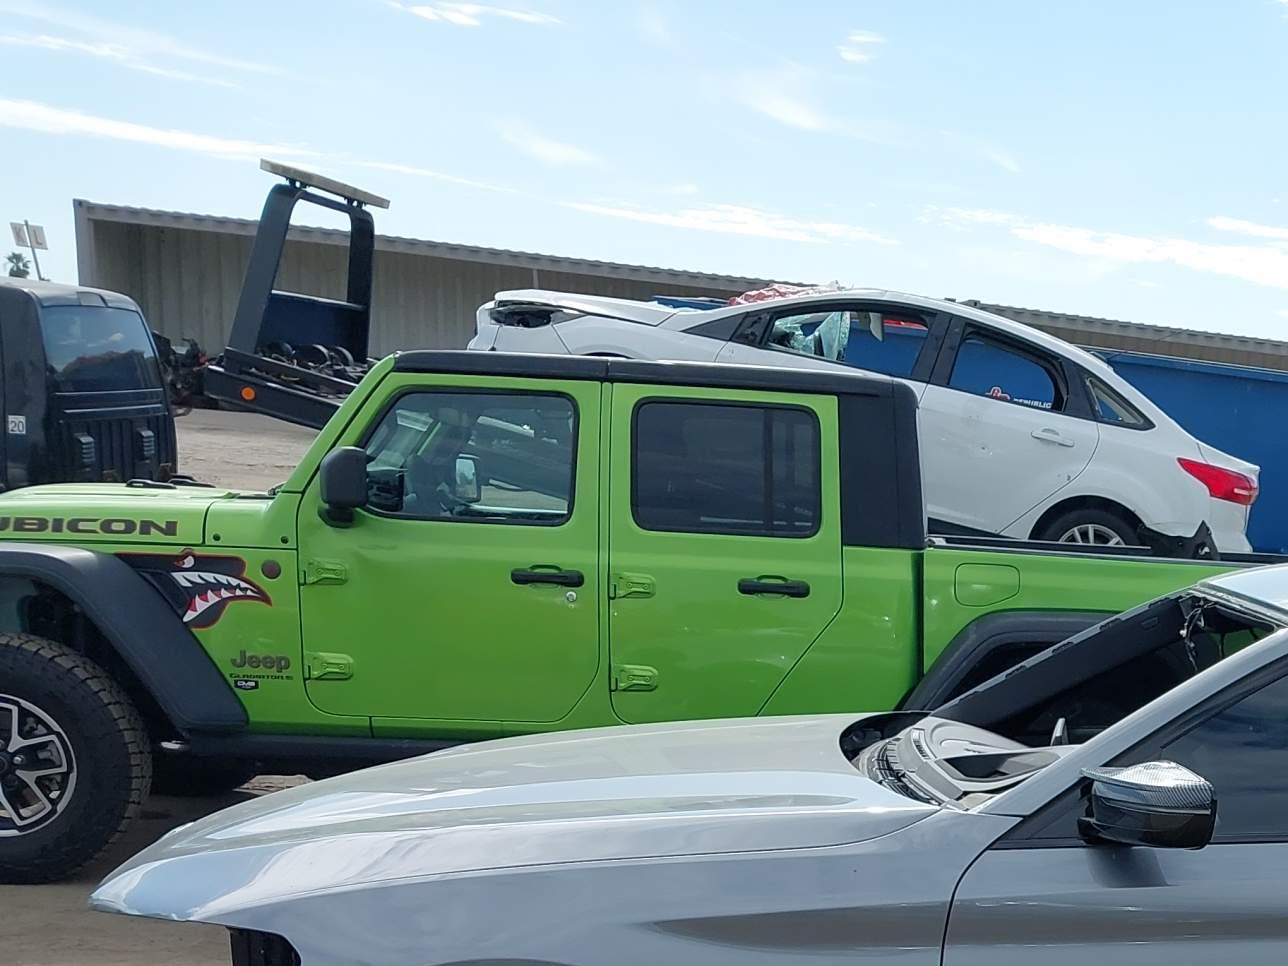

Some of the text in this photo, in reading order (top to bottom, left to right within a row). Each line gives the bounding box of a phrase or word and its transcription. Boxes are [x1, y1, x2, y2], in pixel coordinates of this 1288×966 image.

[10, 420, 25, 433] 20
[0, 516, 178, 537] BICON
[230, 649, 290, 673] Jeep
